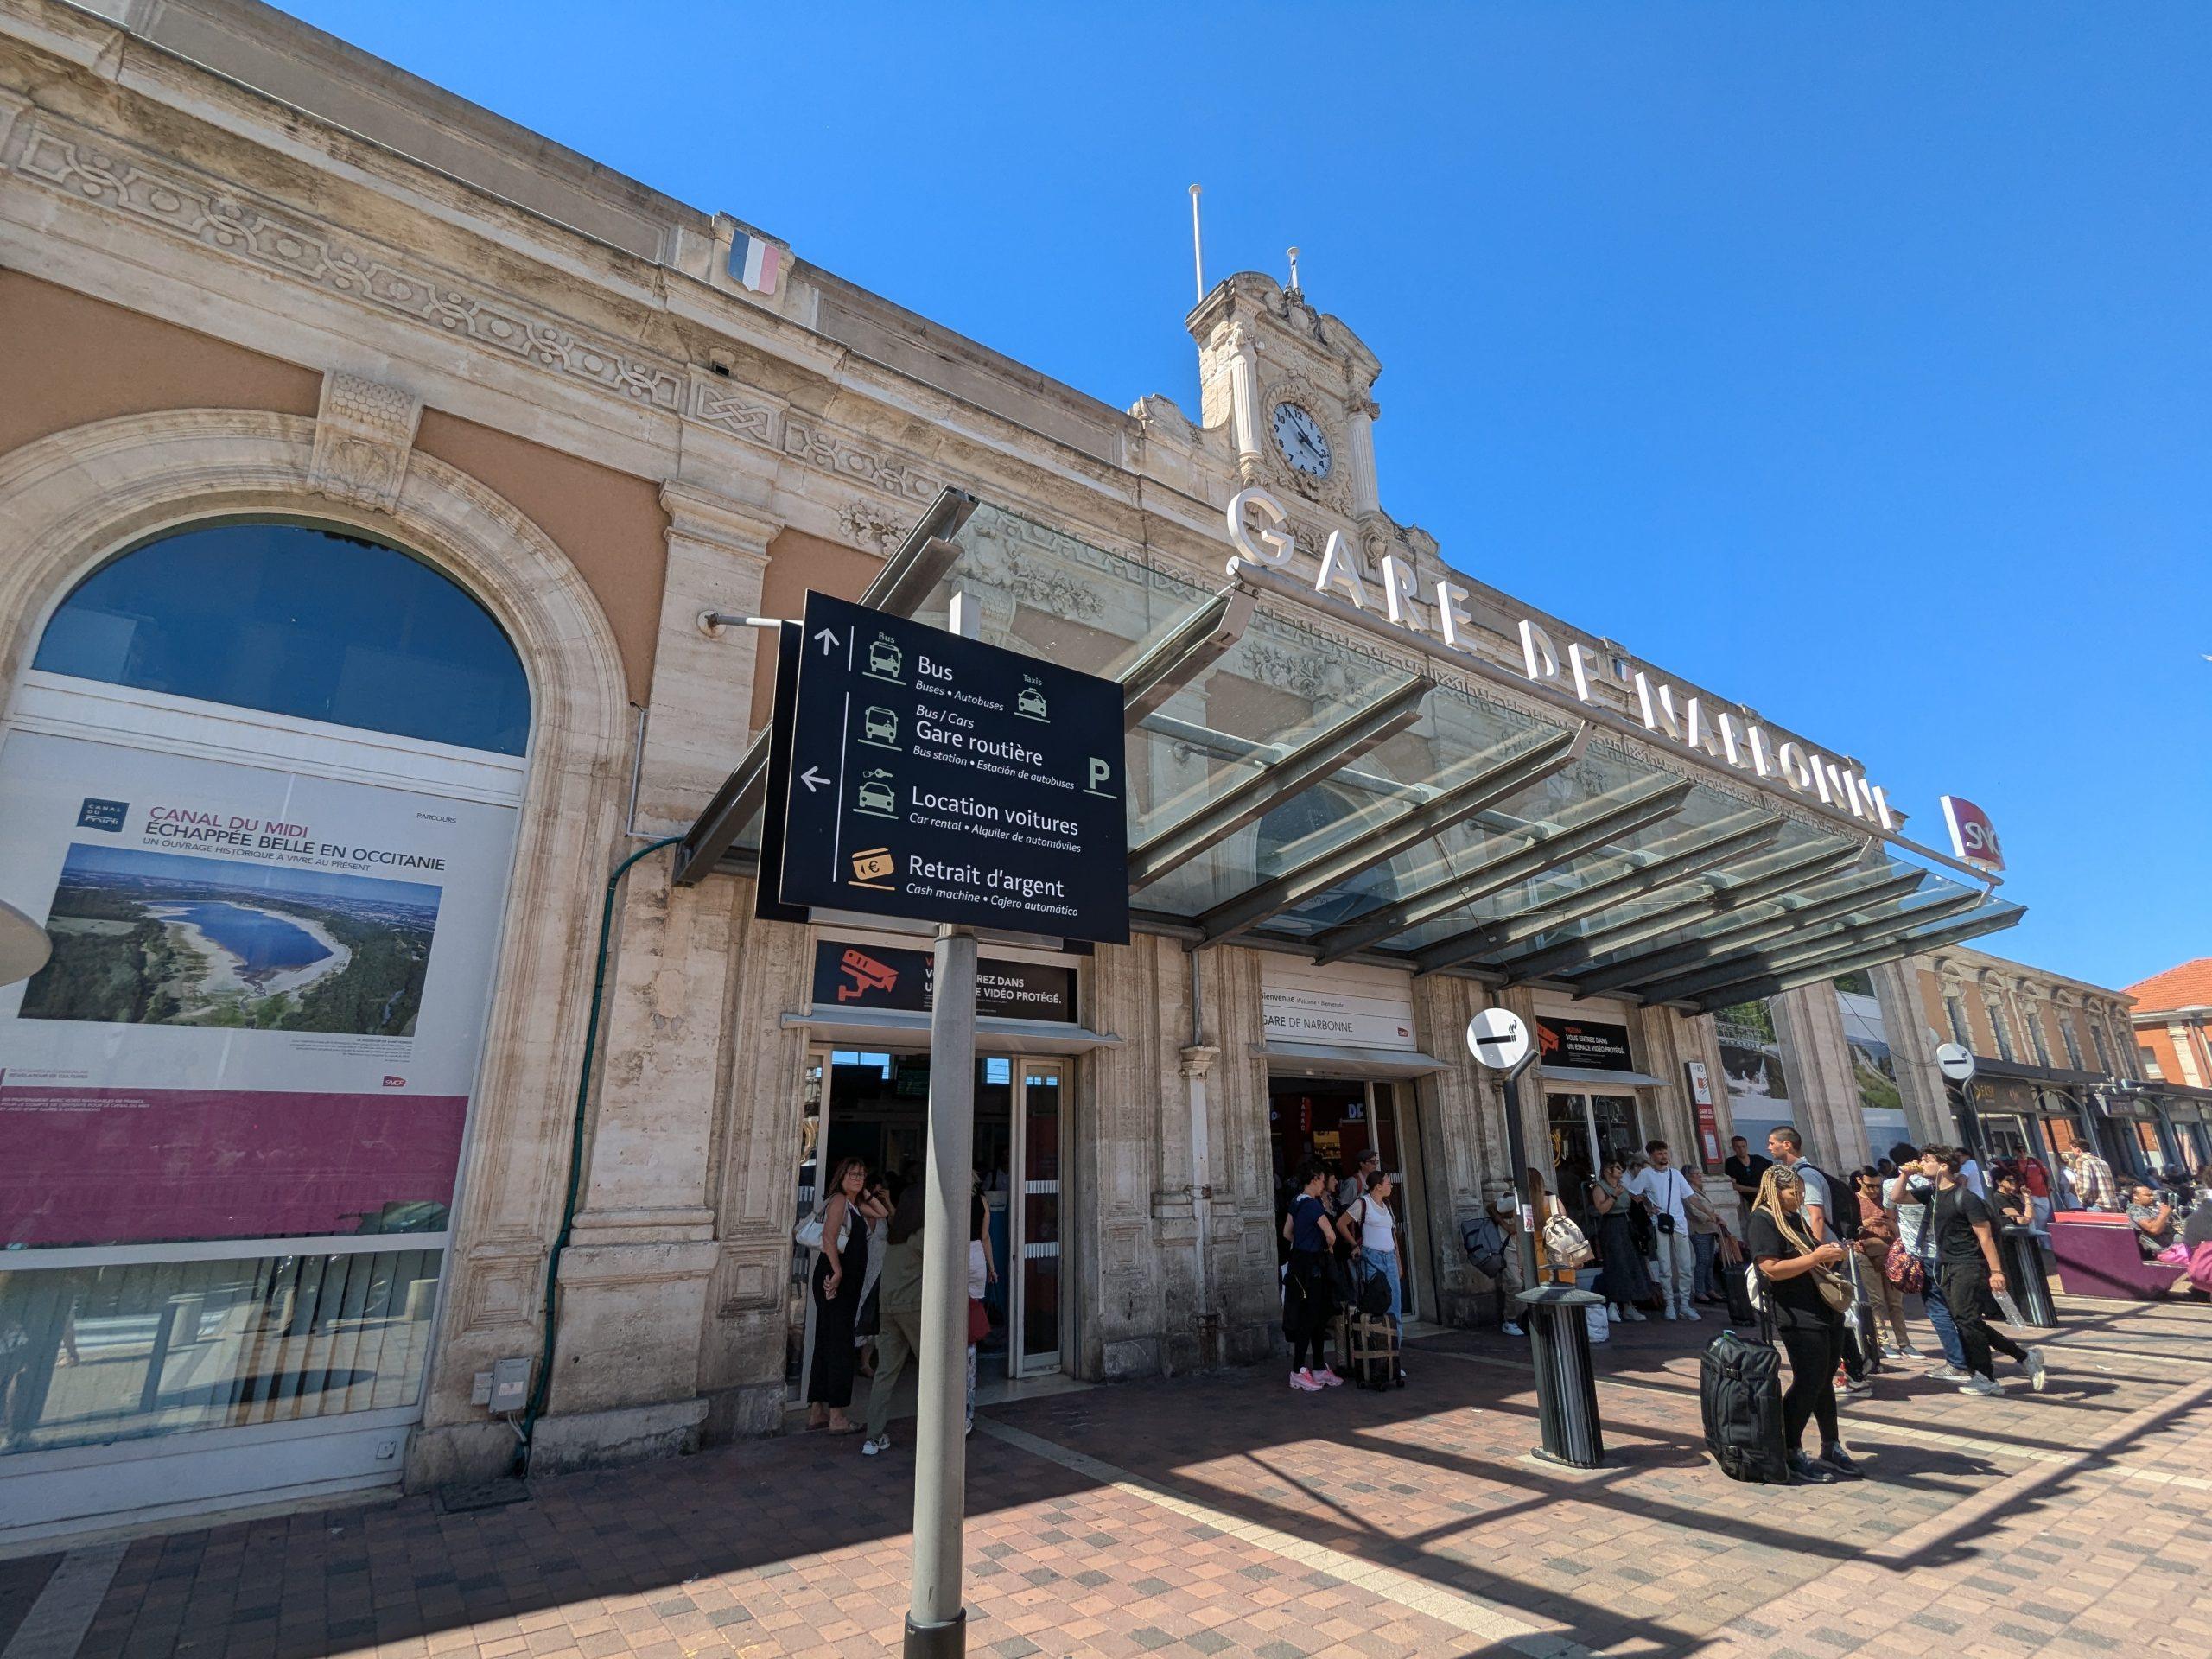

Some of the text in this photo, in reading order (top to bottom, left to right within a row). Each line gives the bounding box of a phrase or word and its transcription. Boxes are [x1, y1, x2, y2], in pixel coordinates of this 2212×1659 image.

[1276, 413, 1286, 424] 10
[1294, 410, 1303, 421] 12
[1308, 420, 1313, 430] 1
[1274, 424, 1280, 433] 9
[1279, 439, 1285, 448] 8
[1316, 435, 1323, 444] 2
[1287, 454, 1294, 462] 7
[1312, 466, 1318, 474] 5
[878, 632, 895, 645] Bus
[918, 655, 954, 682] Bus
[1227, 486, 1910, 833] GARE DE NARBONNE
[1023, 673, 1042, 686] Taxis
[916, 680, 1004, 712] Buses Autobuses
[916, 704, 938, 720] Bus
[948, 713, 975, 729] Cars
[916, 721, 1043, 766] Gare routière
[913, 745, 1075, 790] Bus station Estación de autobuses
[1088, 757, 1110, 790] P
[88, 804, 121, 813] CANAL
[416, 812, 457, 824] PARCOURS
[912, 785, 1078, 836] Location voitures
[149, 806, 308, 838] CANAL DU MIDI
[909, 813, 1082, 853] Car rental Alquiler de automóviles
[1964, 822, 2000, 858] SNC
[143, 837, 159, 846] UN
[162, 840, 213, 852] OUVRAGE
[215, 846, 274, 860] HISTORIQUE
[287, 855, 314, 865] VIVRE
[331, 860, 372, 872] PRÉSENT
[145, 817, 446, 871] ÉCHAPPÉE BELLE EN OCCITANIE
[909, 855, 1065, 899] Retrait d'argent
[906, 882, 1078, 917] Cash machine Cajero automático
[997, 976, 1024, 988] DANS
[983, 986, 1014, 1000] VIDÉO
[1016, 989, 1062, 1004] PROTÉGÉ.
[1288, 1017, 1302, 1028] DE
[1303, 1019, 1353, 1033] NARBONNE
